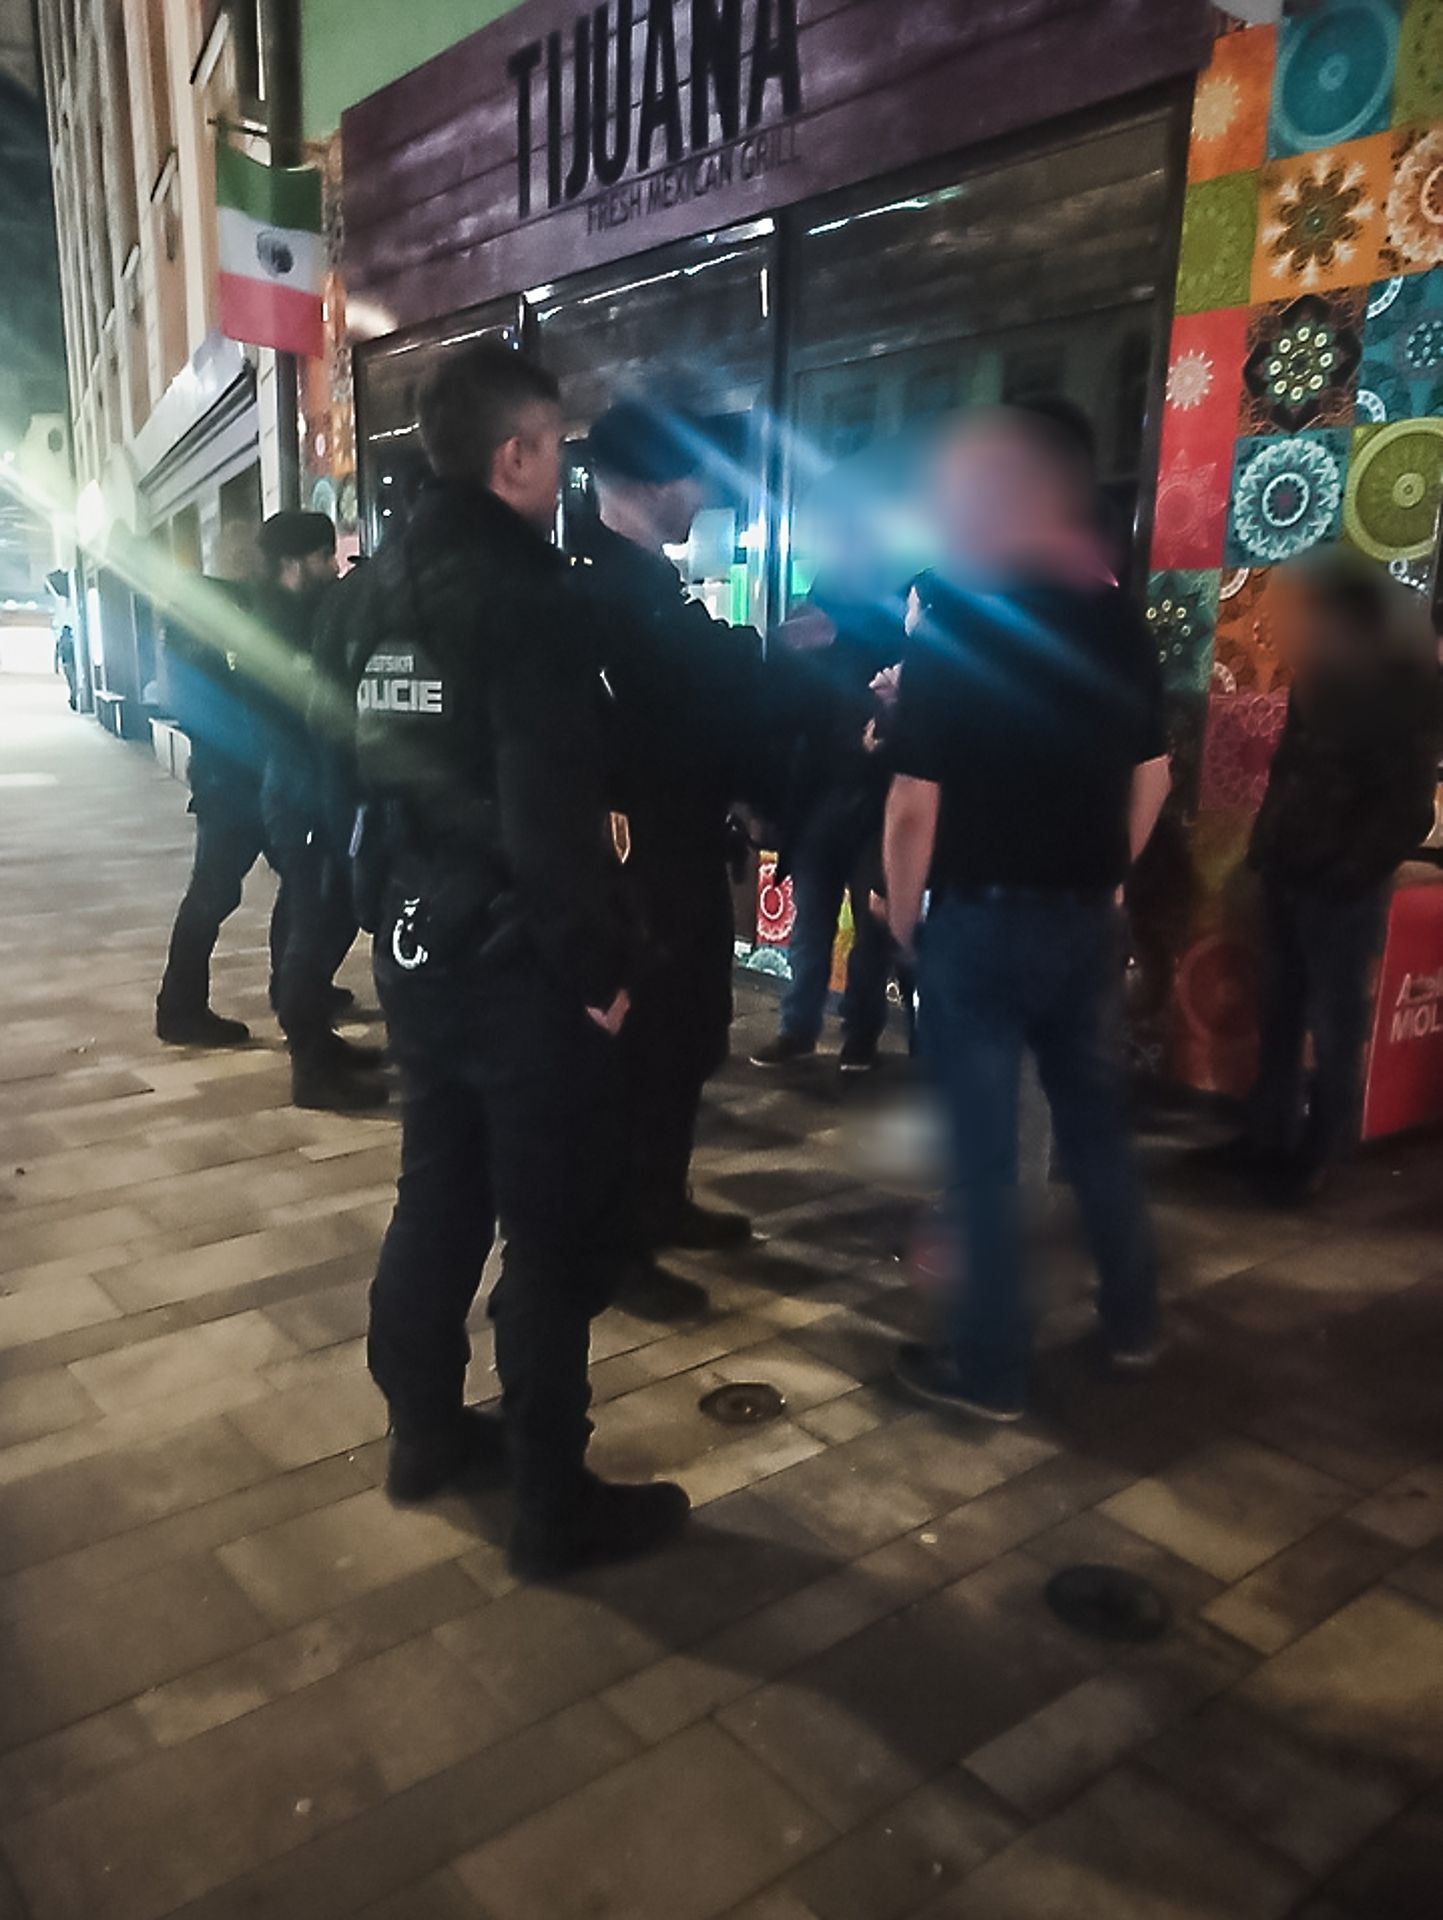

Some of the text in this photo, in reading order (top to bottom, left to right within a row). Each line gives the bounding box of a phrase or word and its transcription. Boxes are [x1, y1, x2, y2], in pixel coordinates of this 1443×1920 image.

[508, 0, 801, 219] TIJUANA
[586, 125, 801, 236] FRESH MEXICAN GRILL
[357, 679, 442, 712] OLICIE
